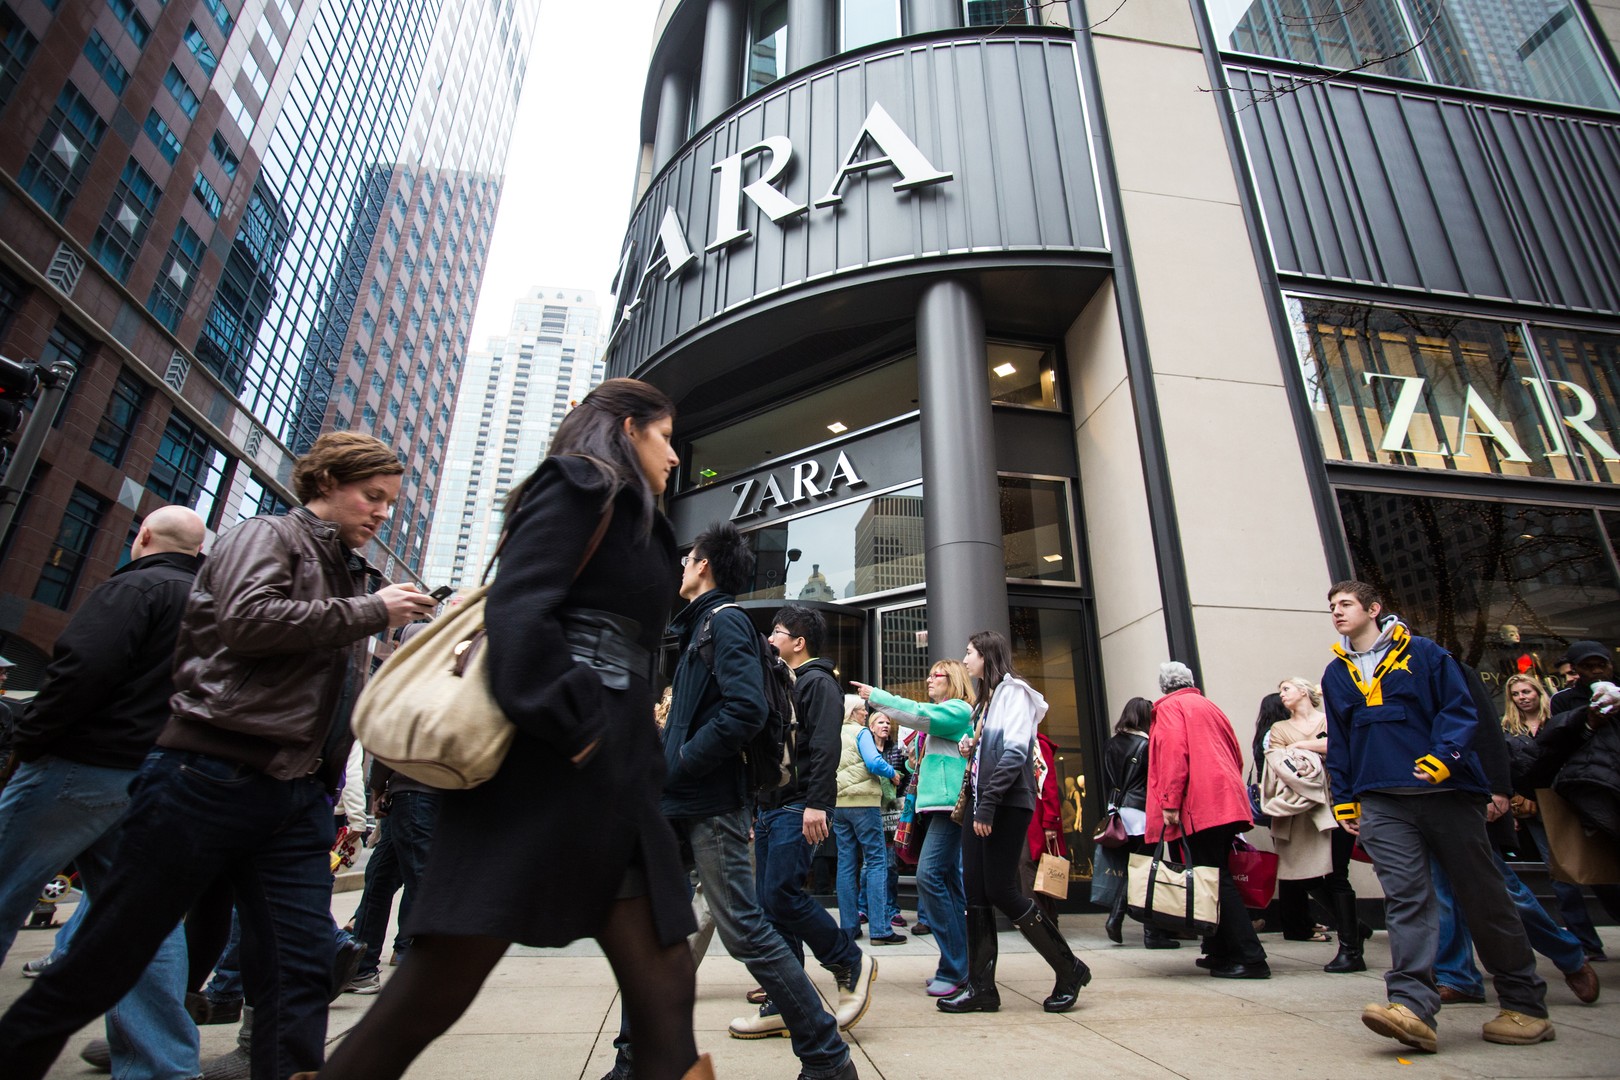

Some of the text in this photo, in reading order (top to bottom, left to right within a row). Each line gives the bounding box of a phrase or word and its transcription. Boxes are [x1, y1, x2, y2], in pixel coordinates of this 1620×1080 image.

[601, 101, 953, 362] ZARA
[1362, 371, 1620, 463] ZAR
[729, 450, 863, 520] ZARA
[1104, 867, 1125, 878] ZAR
